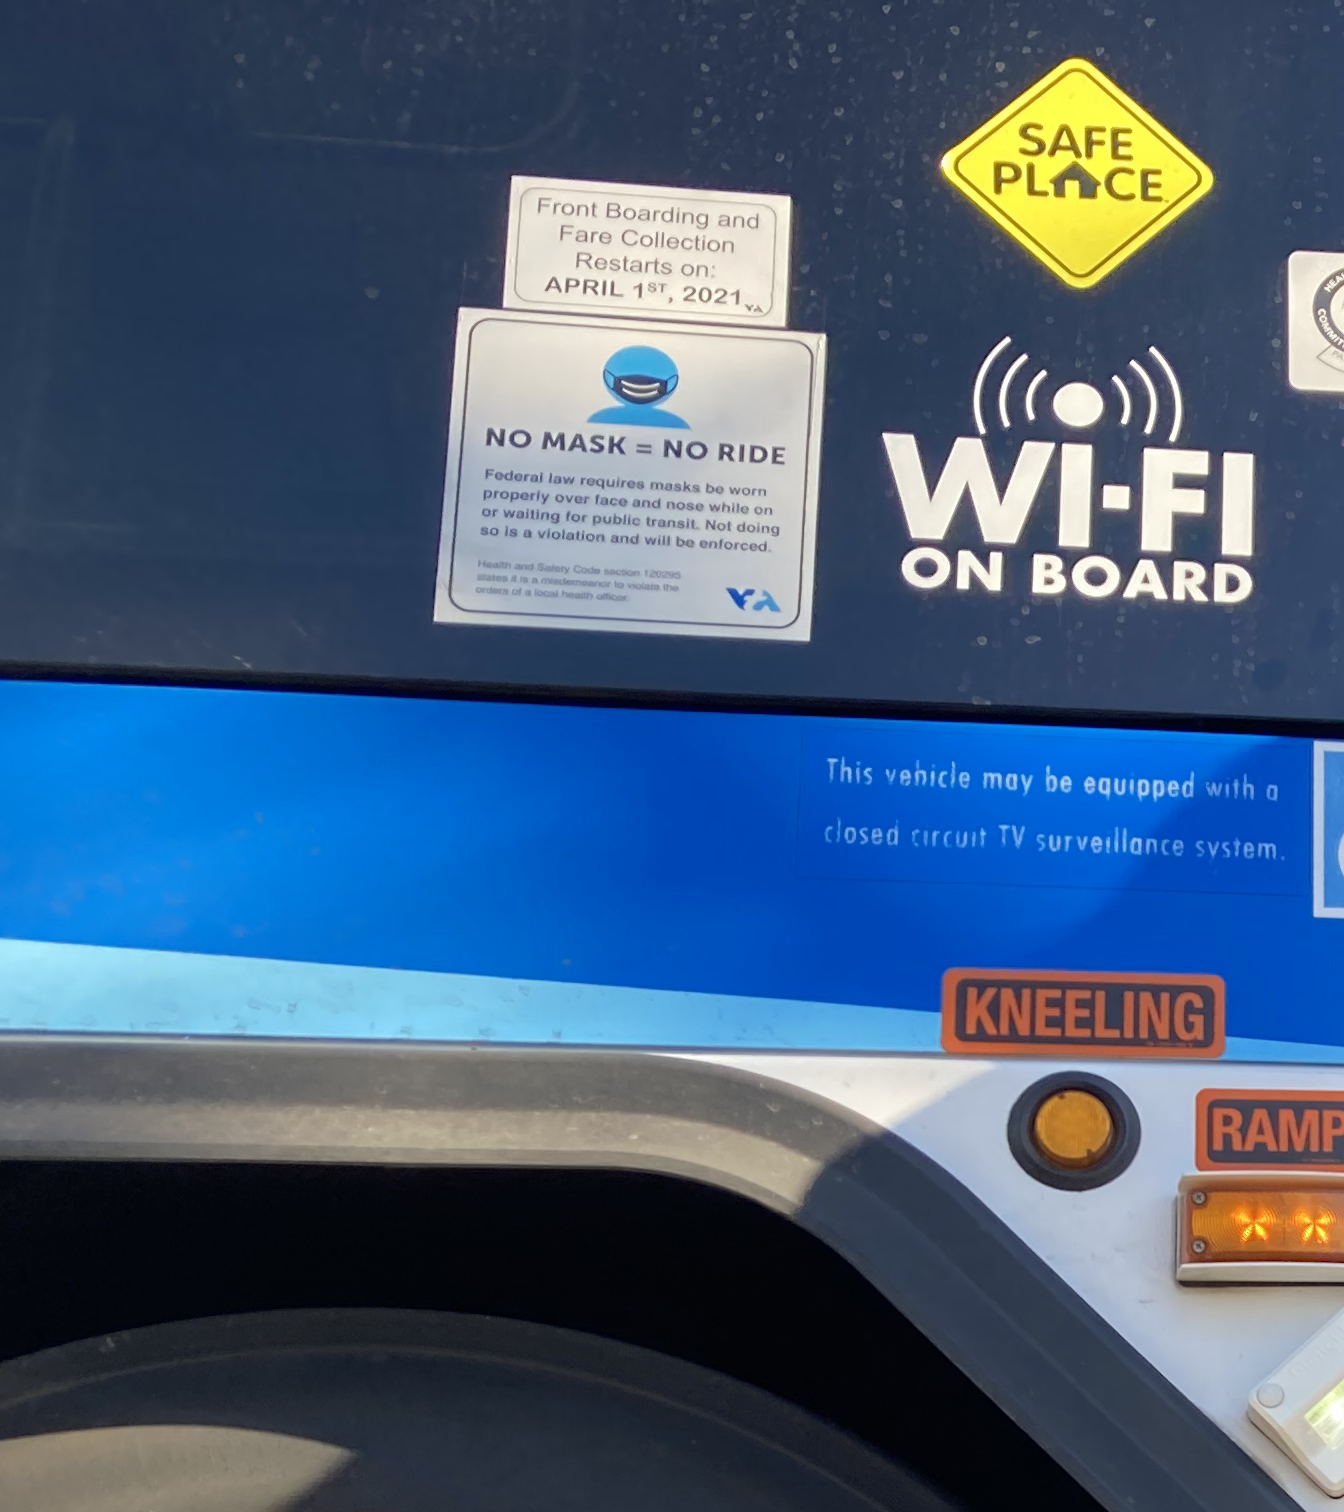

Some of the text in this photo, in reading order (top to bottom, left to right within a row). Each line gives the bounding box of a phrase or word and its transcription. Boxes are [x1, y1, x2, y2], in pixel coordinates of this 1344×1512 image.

[1017, 122, 1134, 163] SAFE
[537, 197, 759, 229] Front Boarding and
[560, 225, 734, 253] Fare Collection
[575, 252, 715, 278] Restarts on:
[544, 277, 624, 298] APRIL
[683, 286, 741, 306] 2021
[485, 427, 532, 448] NO
[541, 431, 627, 455] MASK
[663, 438, 708, 460] NO
[718, 443, 786, 466] RIDE
[484, 469, 767, 497] Federal law requires masks be worn
[483, 488, 773, 516] properly over face and nose while on
[481, 507, 781, 538] or waiting for public transit. Not doing
[480, 525, 772, 554] so is a violation and will be enforced.
[477, 559, 511, 570] Health
[514, 562, 534, 571] and
[537, 562, 570, 575] Safety
[573, 565, 600, 575] Code
[901, 547, 1254, 603] ON BOARD
[826, 756, 1280, 803] This vehicle may be equipped with a
[824, 819, 1287, 864] closed circuit TV surveillance system.
[964, 986, 1206, 1043] KNEELING
